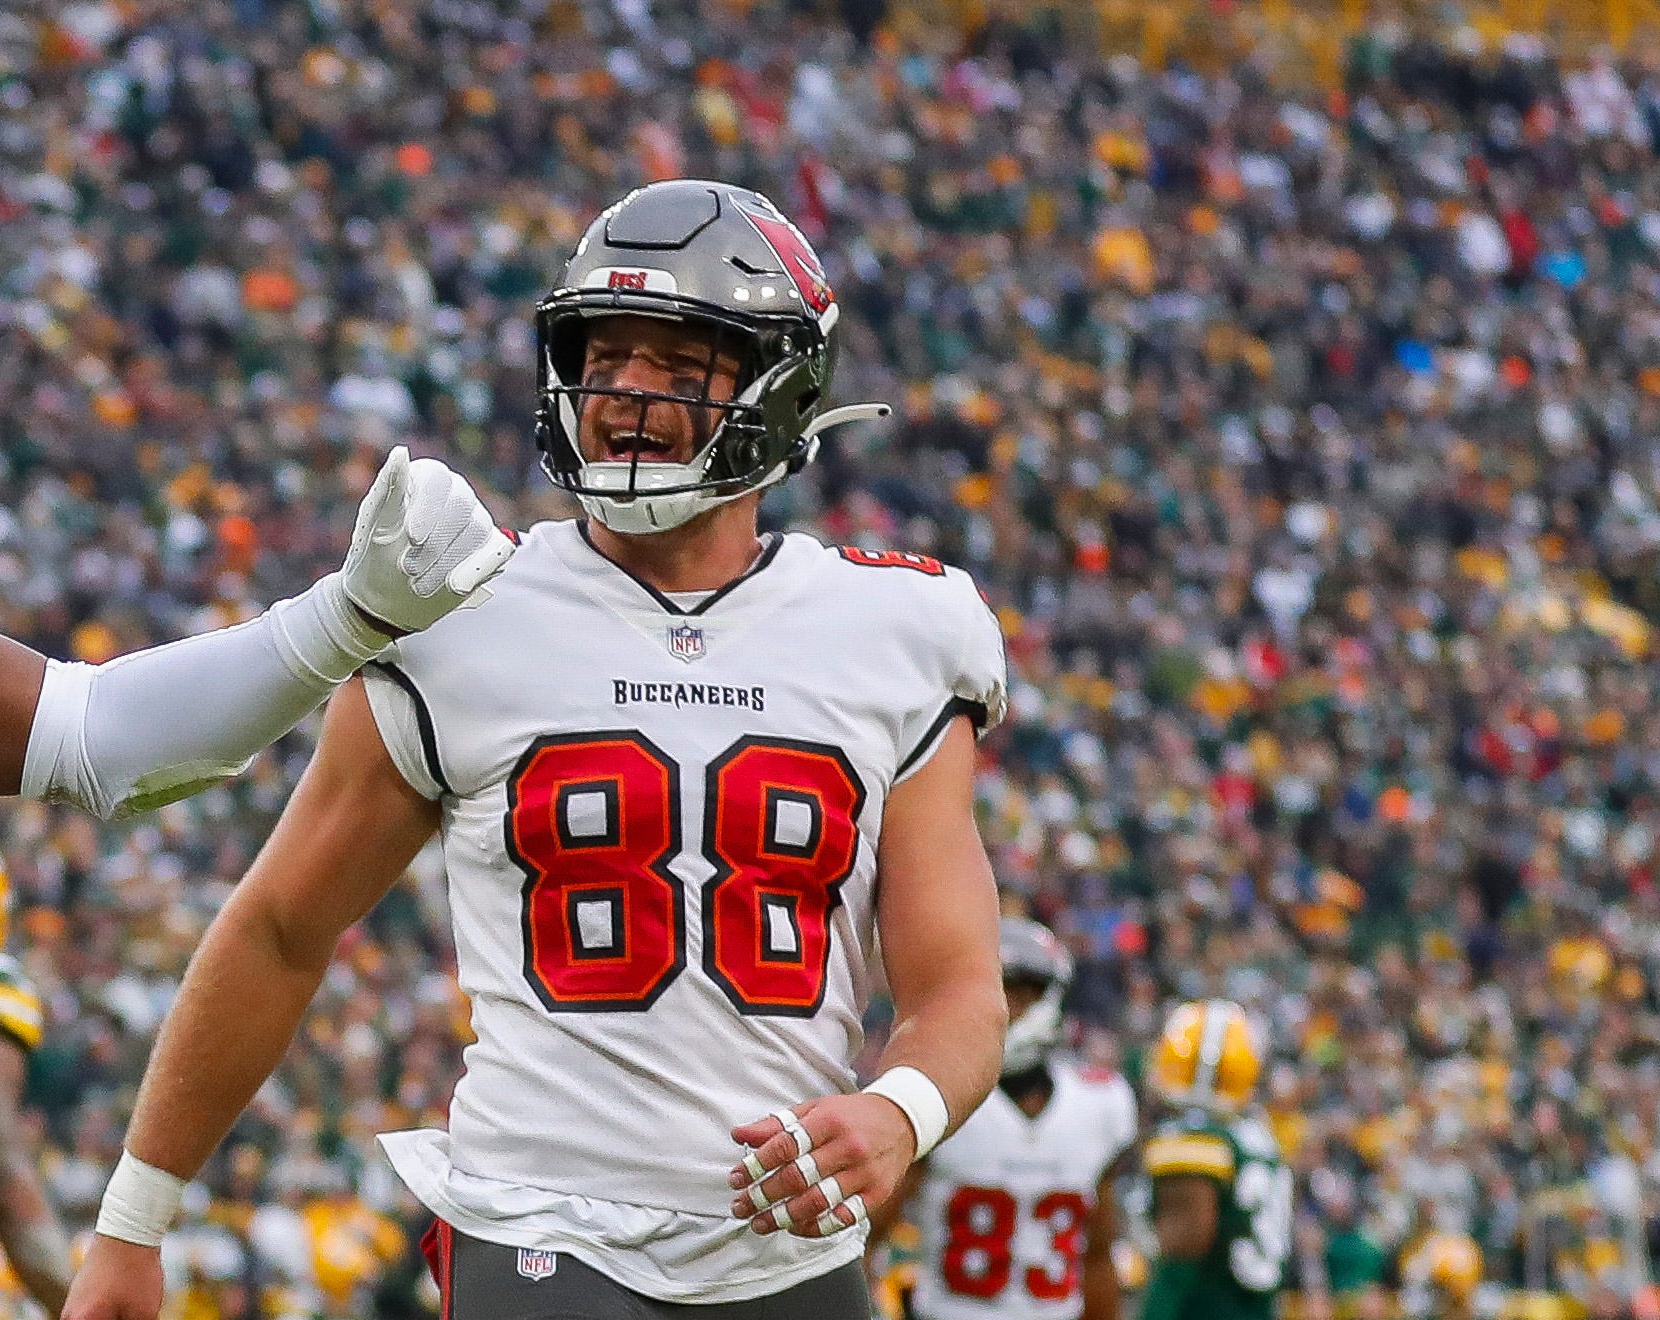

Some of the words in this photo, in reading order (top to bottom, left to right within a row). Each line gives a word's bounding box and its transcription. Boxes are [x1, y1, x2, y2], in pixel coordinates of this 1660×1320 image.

[675, 637, 701, 653] NFL
[612, 679, 766, 712] BUCCANEERS
[503, 729, 868, 1019] 88
[944, 1184, 1088, 1300] 83
